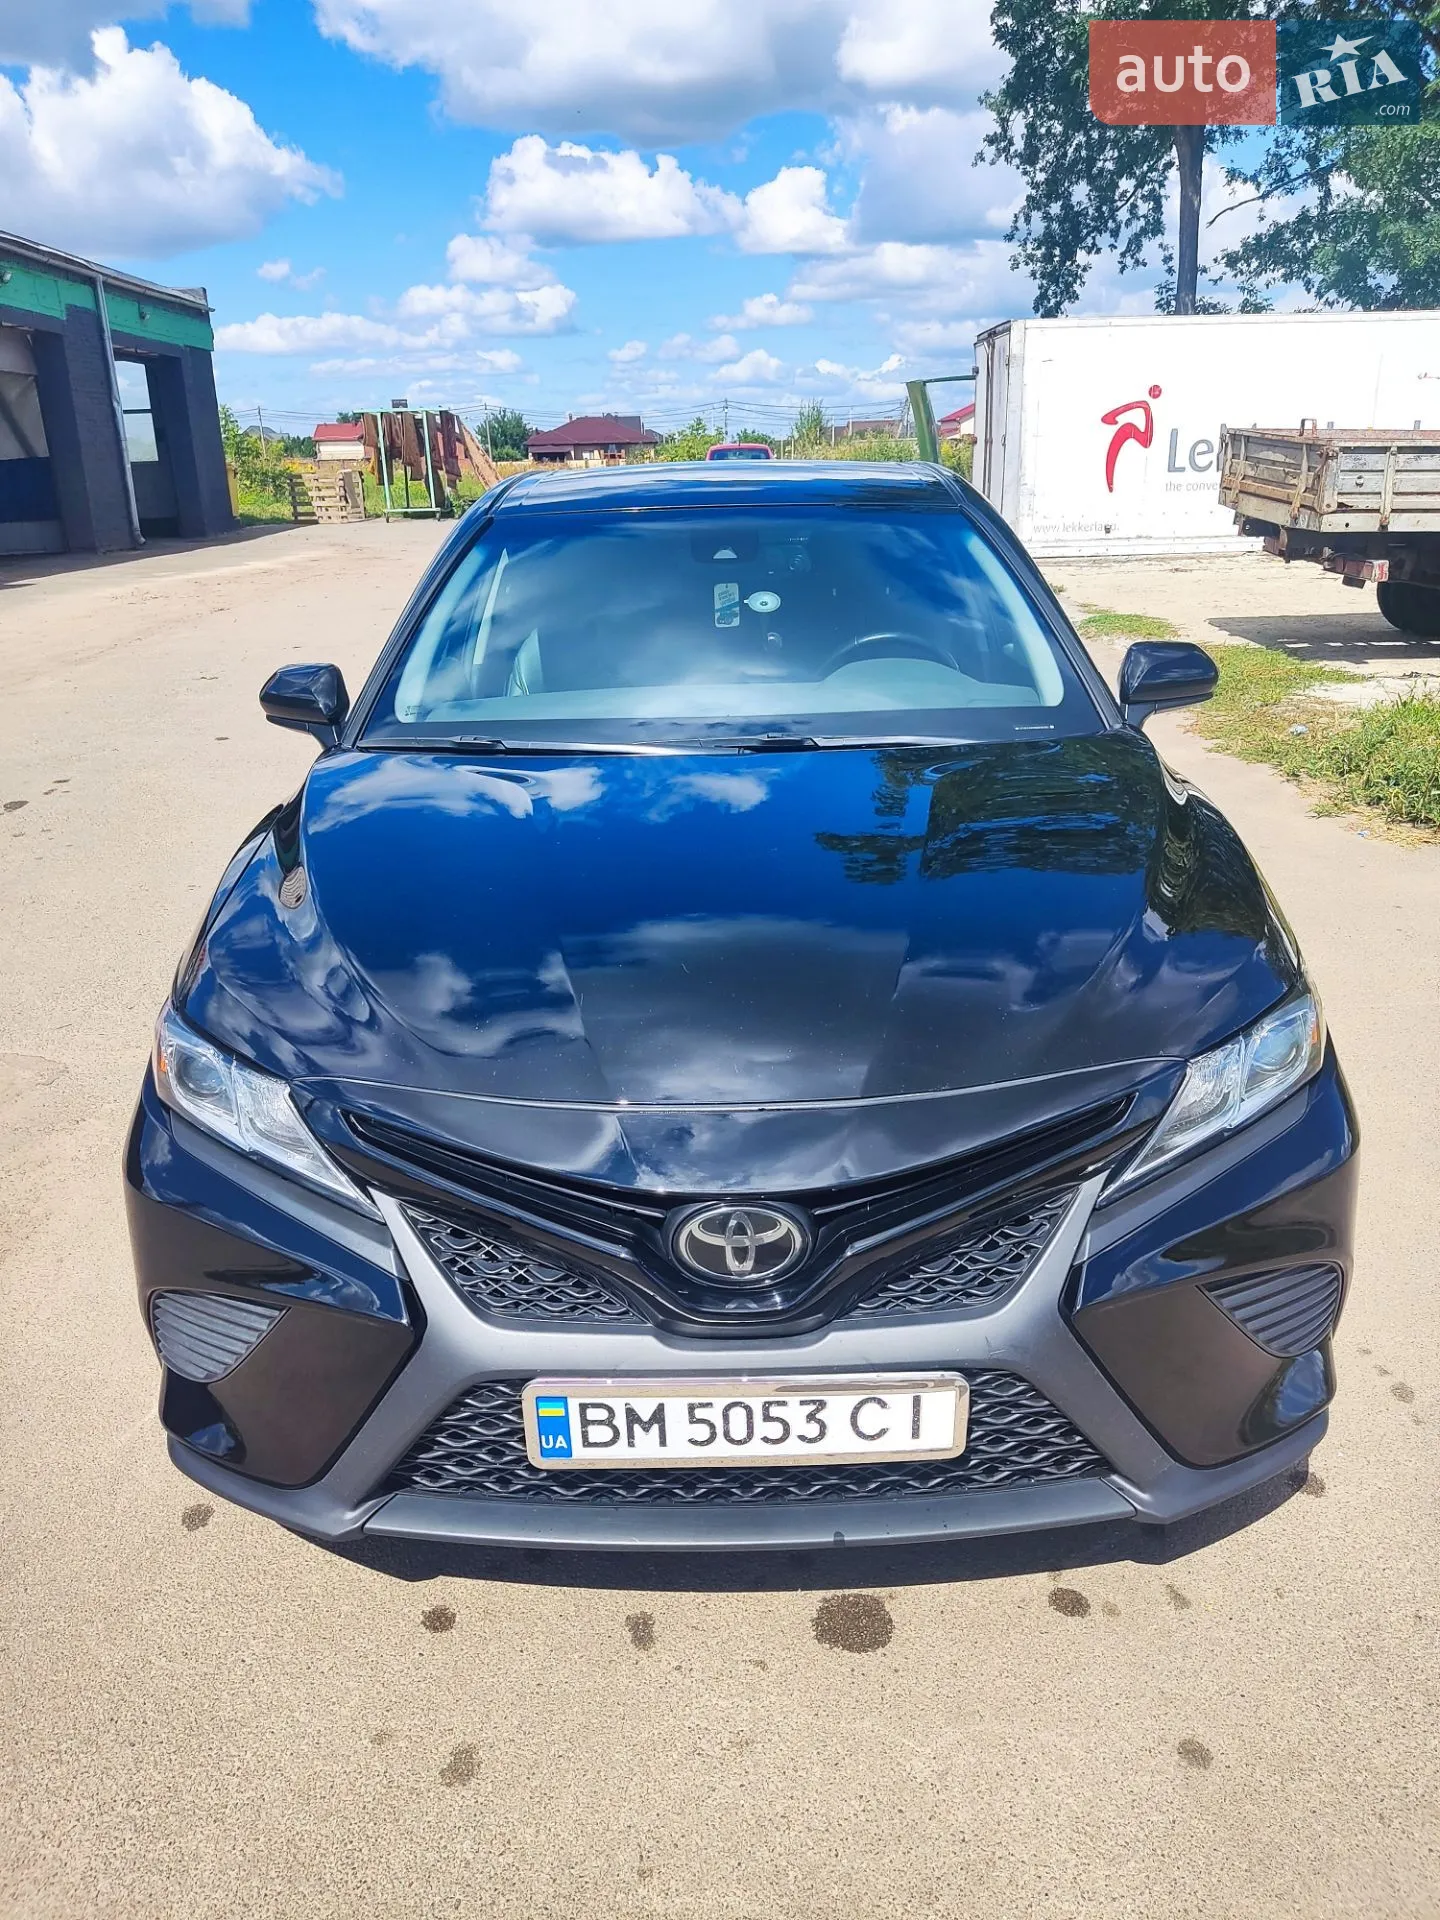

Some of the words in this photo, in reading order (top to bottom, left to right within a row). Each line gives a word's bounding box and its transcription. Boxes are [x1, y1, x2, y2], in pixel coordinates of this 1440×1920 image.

[1165, 481, 1183, 492] the
[578, 1402, 667, 1448] BM
[687, 1399, 827, 1447] 5053
[541, 1435, 568, 1449] UA
